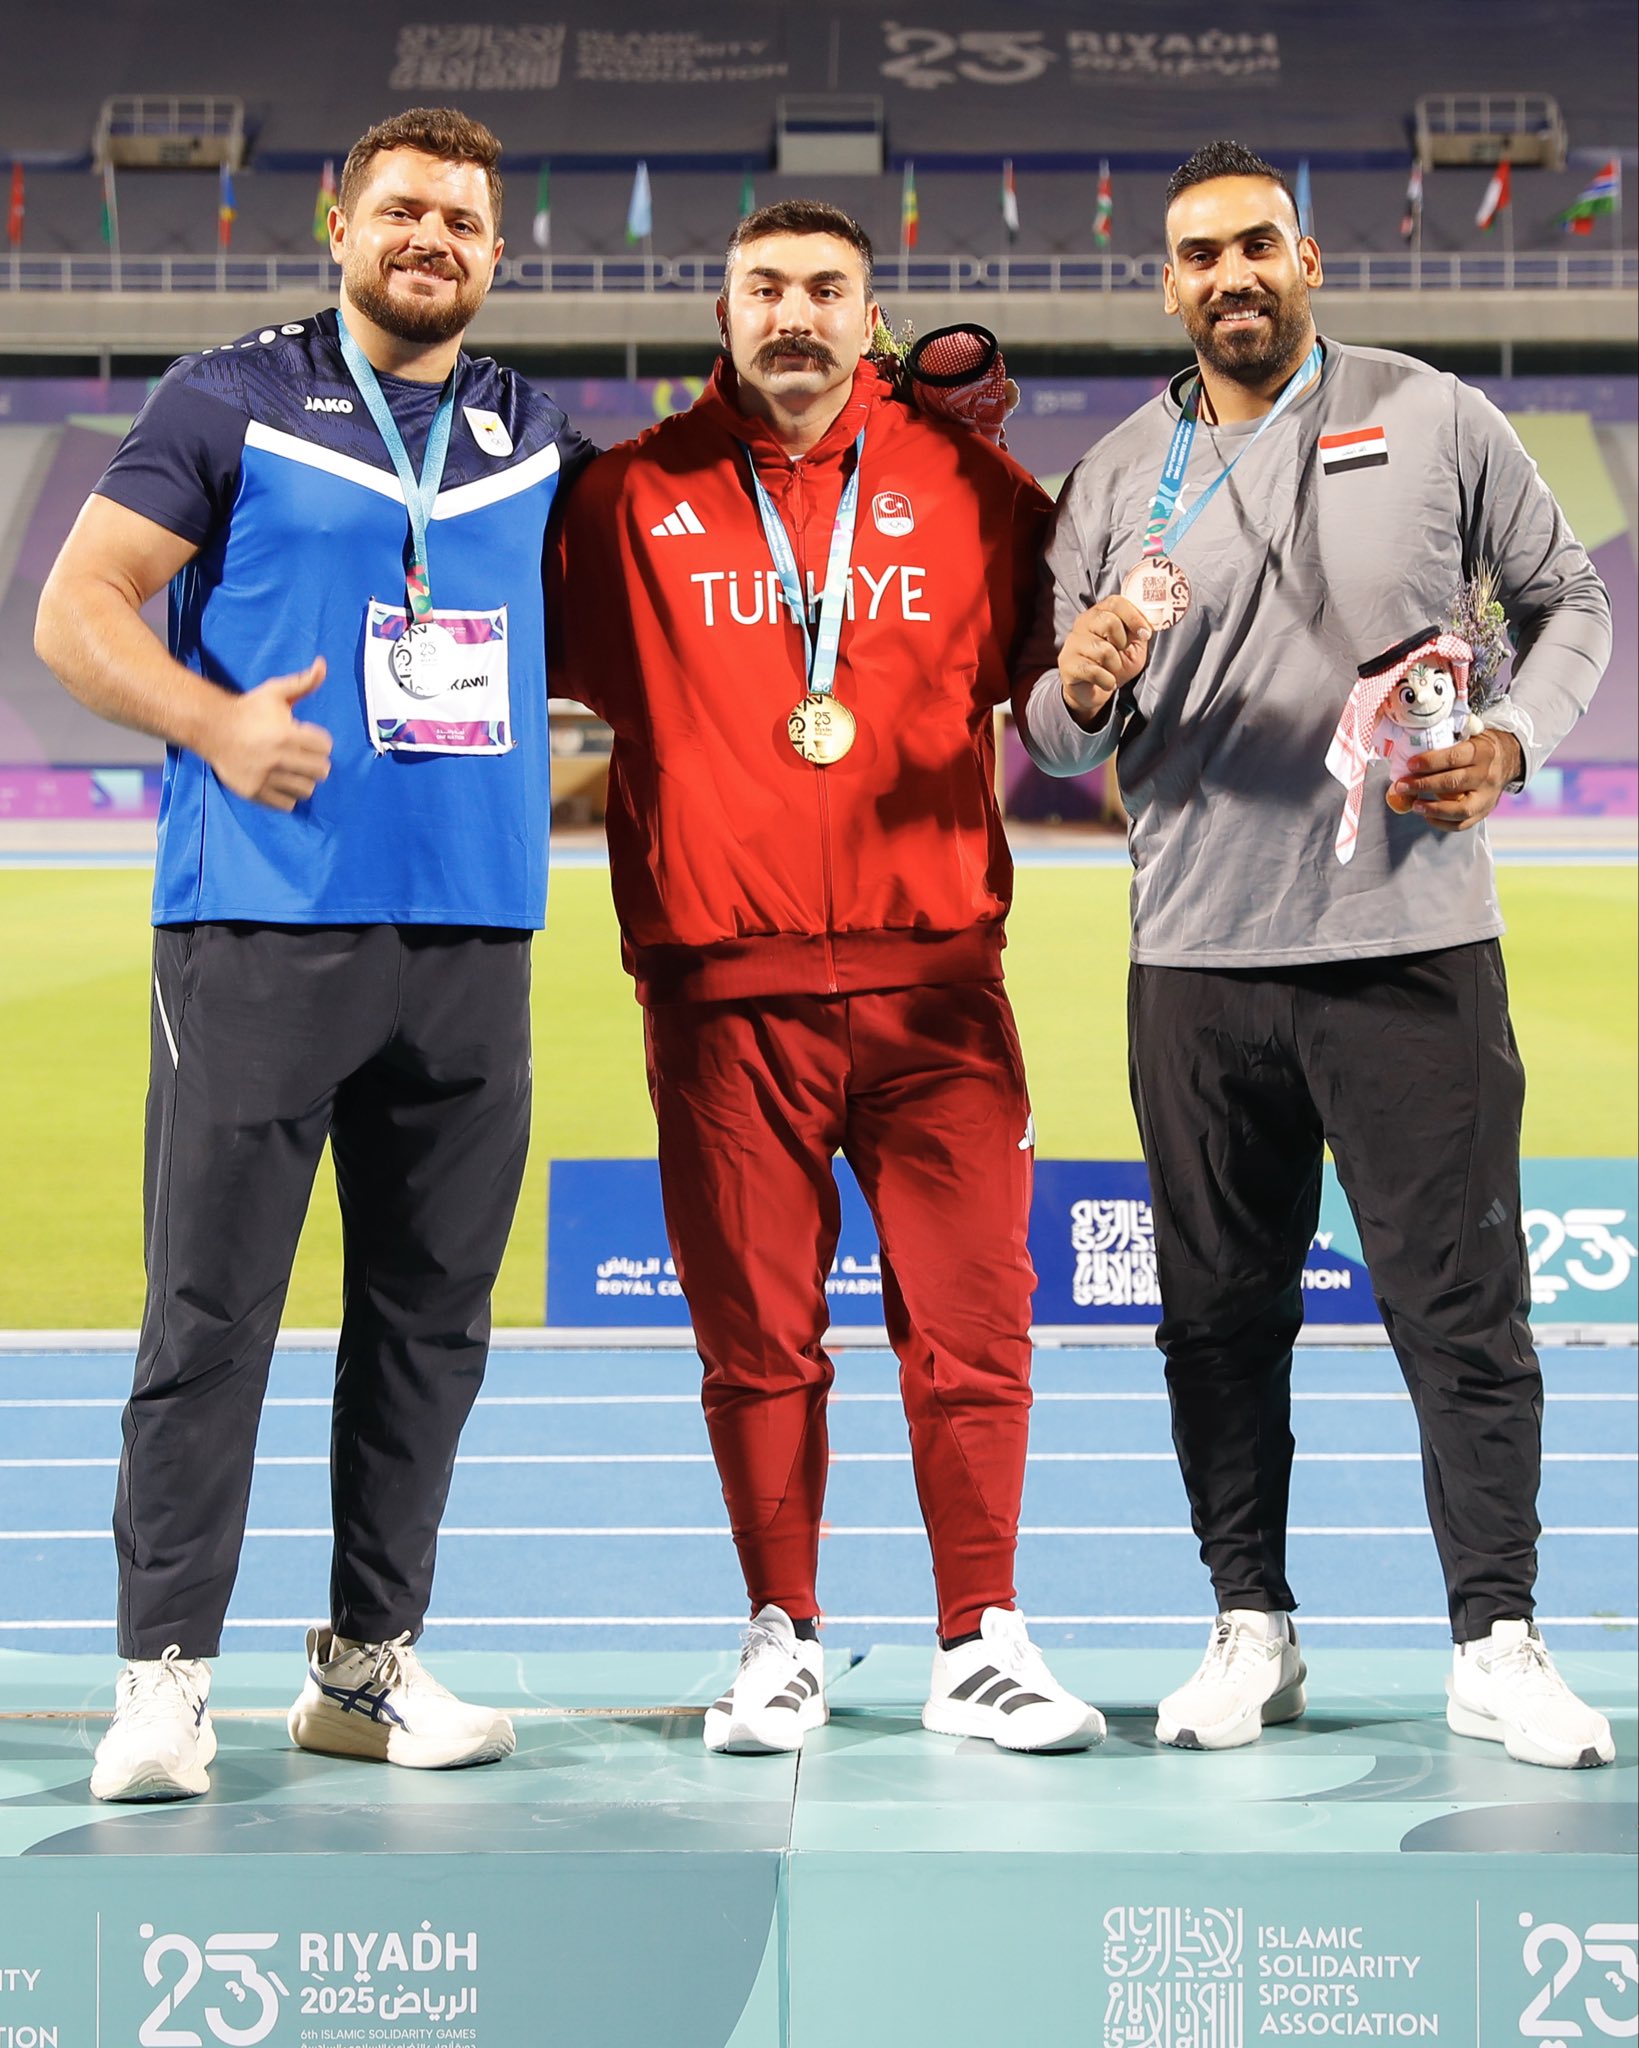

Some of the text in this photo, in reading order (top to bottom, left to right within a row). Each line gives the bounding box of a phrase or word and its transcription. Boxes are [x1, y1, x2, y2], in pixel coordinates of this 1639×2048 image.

[304, 395, 353, 414] JAKO
[814, 711, 831, 725] 25
[1522, 1209, 1634, 1297] 25
[596, 1280, 655, 1295] ROYAL
[825, 1279, 882, 1295] IYADH
[1258, 1926, 1363, 1949] ISLAMIC
[300, 1919, 477, 1980] RIYADH
[1258, 1955, 1421, 1978] SOLIDARITY
[1518, 1912, 1638, 2041] 25
[139, 1923, 284, 2047] 25
[1258, 1984, 1360, 2006] SPORTS
[300, 1984, 477, 2021] 2025 الرياض
[300, 2029, 477, 2040] 6th ISLAMIC SOLIDARITY GAMES
[1259, 2012, 1439, 2036] ASSOCIATION
